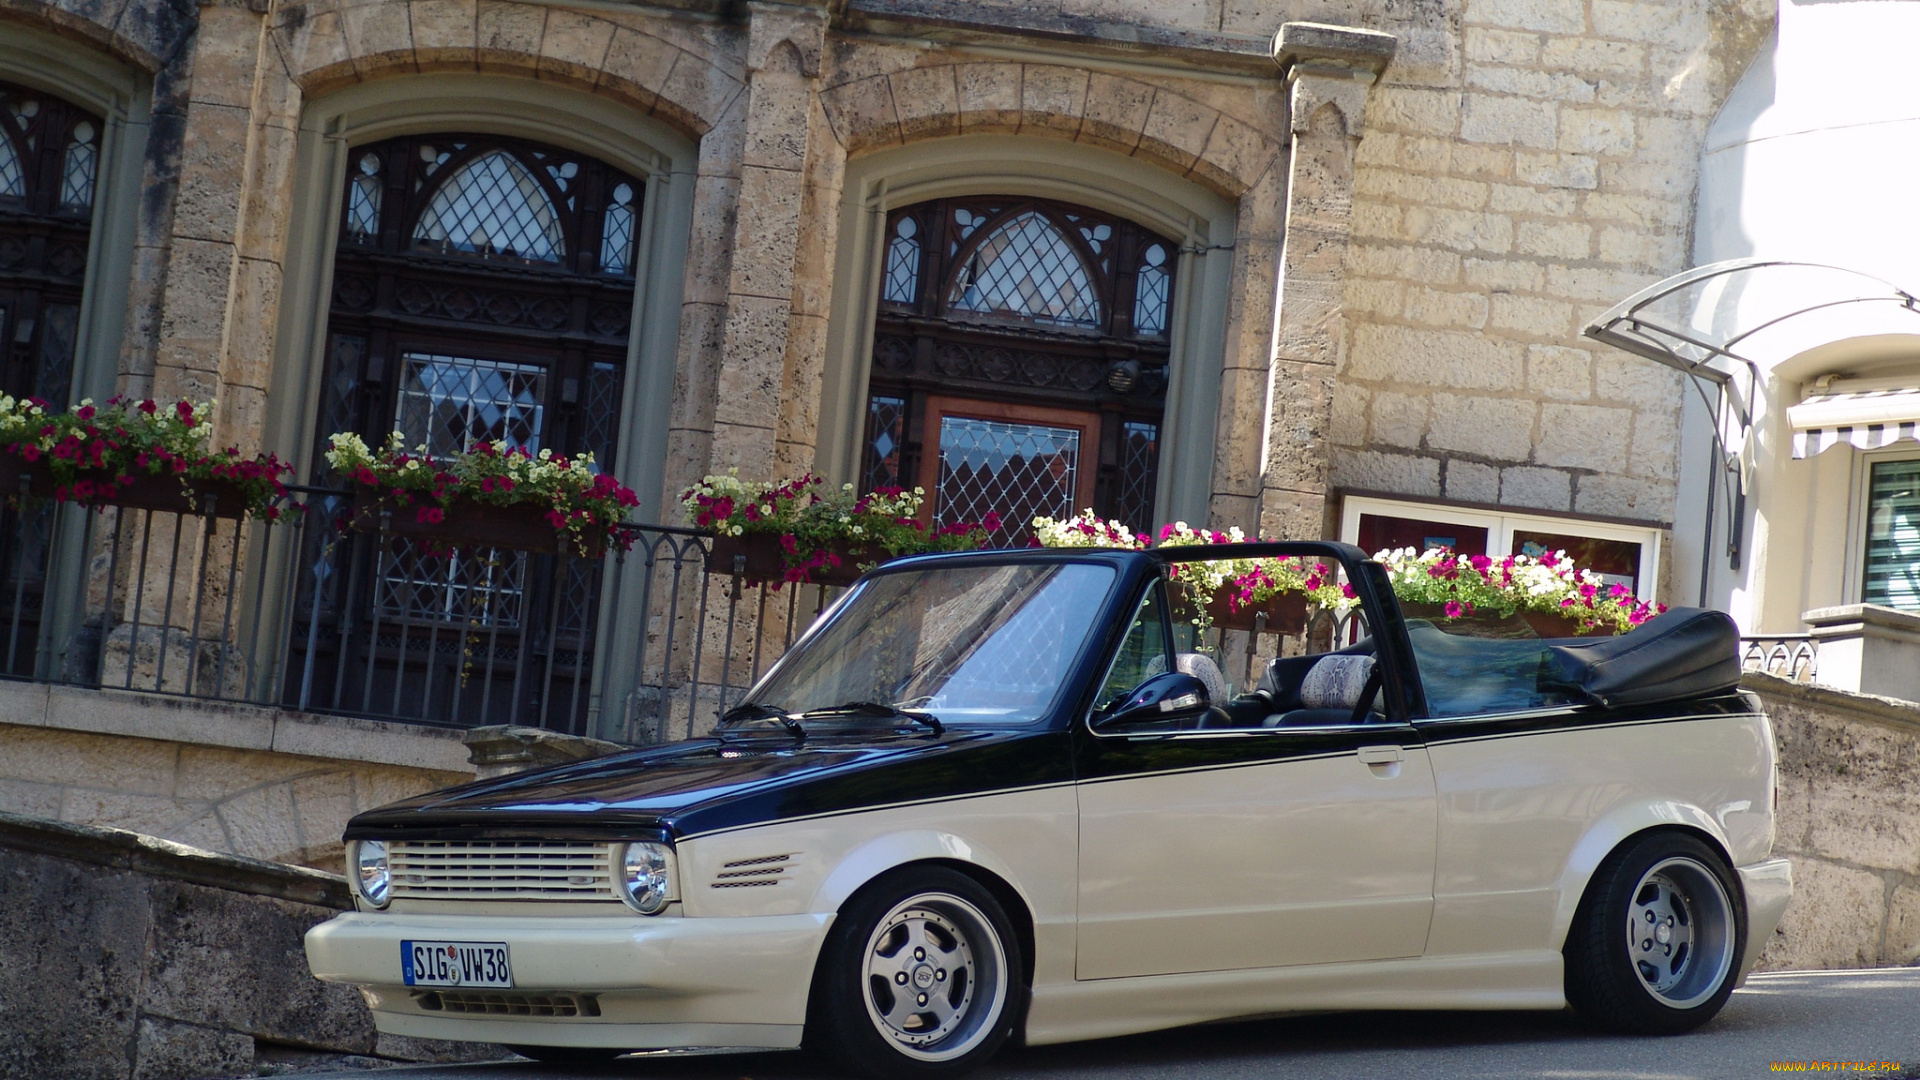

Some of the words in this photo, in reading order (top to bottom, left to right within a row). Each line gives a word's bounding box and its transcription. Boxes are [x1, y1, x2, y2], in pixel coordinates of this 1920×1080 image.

[406, 967, 412, 977] D
[414, 946, 448, 980] SIG
[460, 948, 508, 982] VW38
